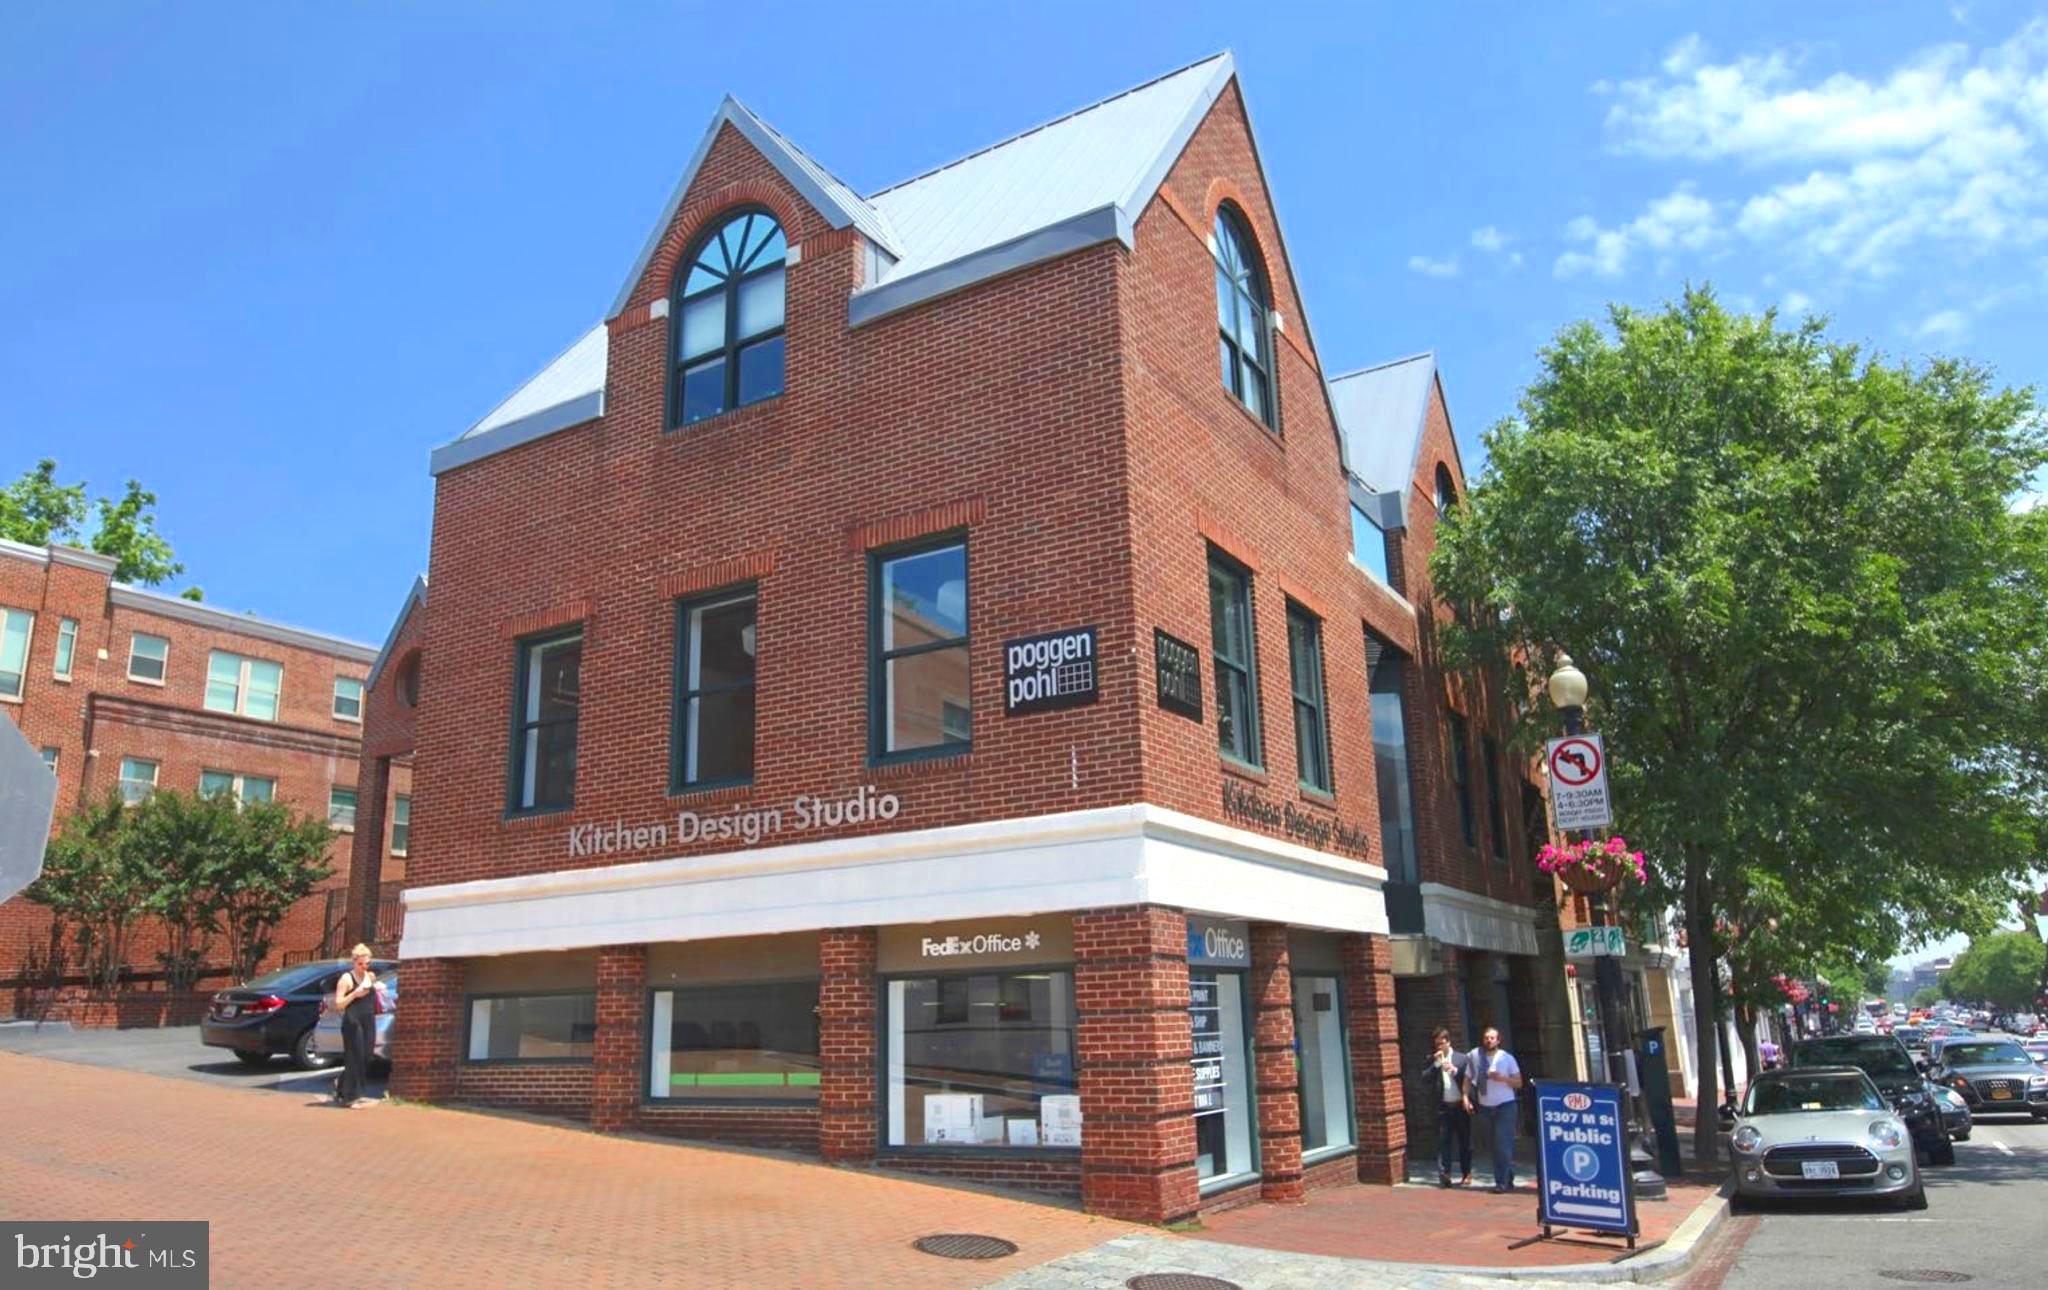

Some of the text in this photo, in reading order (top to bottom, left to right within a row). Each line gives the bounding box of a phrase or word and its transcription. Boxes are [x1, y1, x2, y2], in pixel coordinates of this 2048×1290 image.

[1008, 632, 1091, 674] poggen
[1009, 667, 1058, 709] pohl
[568, 785, 900, 858] Kitchen Design Studio
[1222, 778, 1281, 830] Kitchen
[1284, 800, 1331, 851] Design
[973, 934, 1022, 954] Office
[1205, 926, 1245, 959] Office
[1648, 1041, 1659, 1055] P
[1196, 1066, 1221, 1081] SUPPLIES
[1544, 1111, 1615, 1127] 3307 M St
[1549, 1125, 1613, 1146] Public
[1572, 1151, 1590, 1174] P
[1549, 1180, 1621, 1204] Parking
